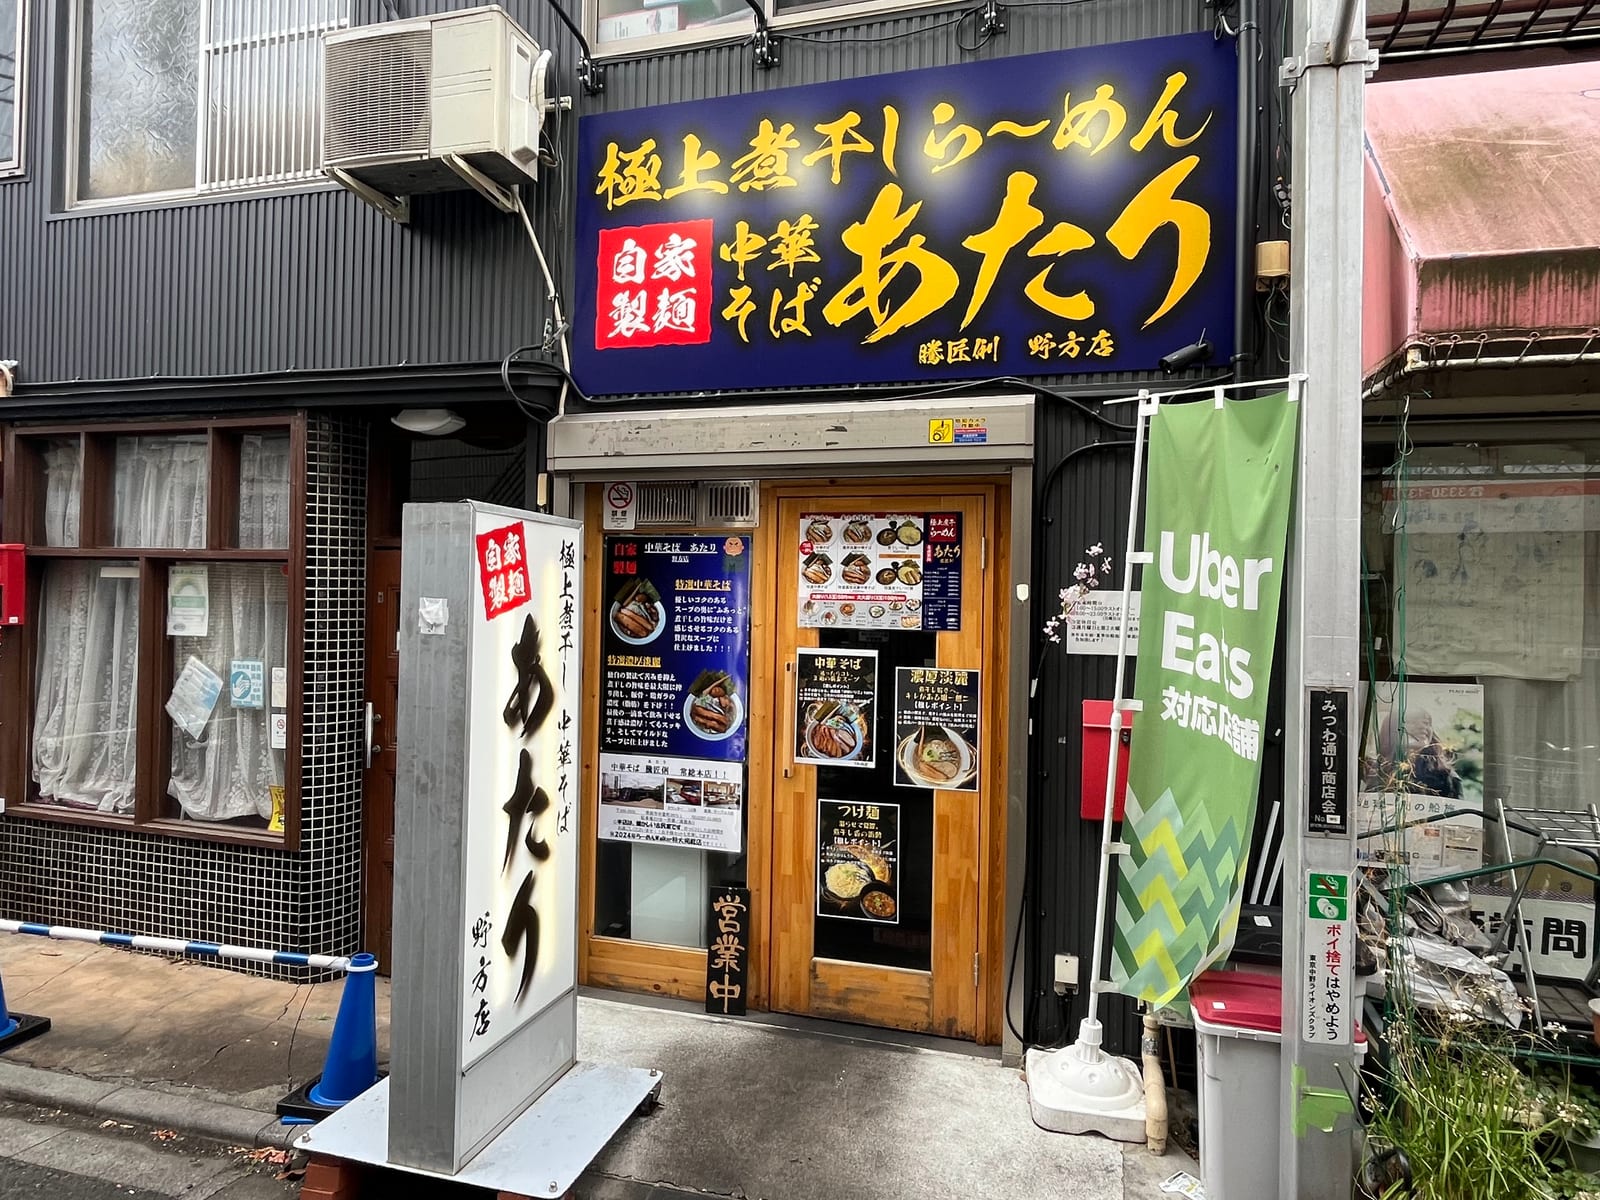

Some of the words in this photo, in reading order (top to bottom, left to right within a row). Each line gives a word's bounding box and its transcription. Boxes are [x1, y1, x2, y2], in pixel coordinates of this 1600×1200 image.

[611, 233, 697, 285] 自家
[719, 213, 822, 277] 中華
[822, 154, 1213, 346] あたり
[608, 286, 697, 337] 製麺
[721, 276, 822, 345] そば
[1027, 328, 1115, 360] 野方店
[484, 530, 522, 574] 自家
[644, 542, 682, 553] 中華そば
[689, 543, 717, 553] あたり
[1159, 531, 1273, 611] Uber
[557, 538, 577, 694] 極上煮干し
[1161, 610, 1254, 700] Eats
[815, 657, 862, 670] 中華そば
[911, 670, 968, 686] 濃厚淡麗
[1160, 685, 1260, 762] 対応店舗
[1321, 700, 1337, 814] みつわ通り商店会
[500, 611, 555, 1006] あたり
[555, 708, 574, 836] 中華そば
[838, 805, 880, 820] つけ麺
[471, 910, 494, 1043] 野方店
[709, 894, 747, 1014] 営業中
[1325, 924, 1342, 1041] ポイ捨てはやめよう
[1308, 954, 1317, 1039] 東京中野ライオンズクラブ
